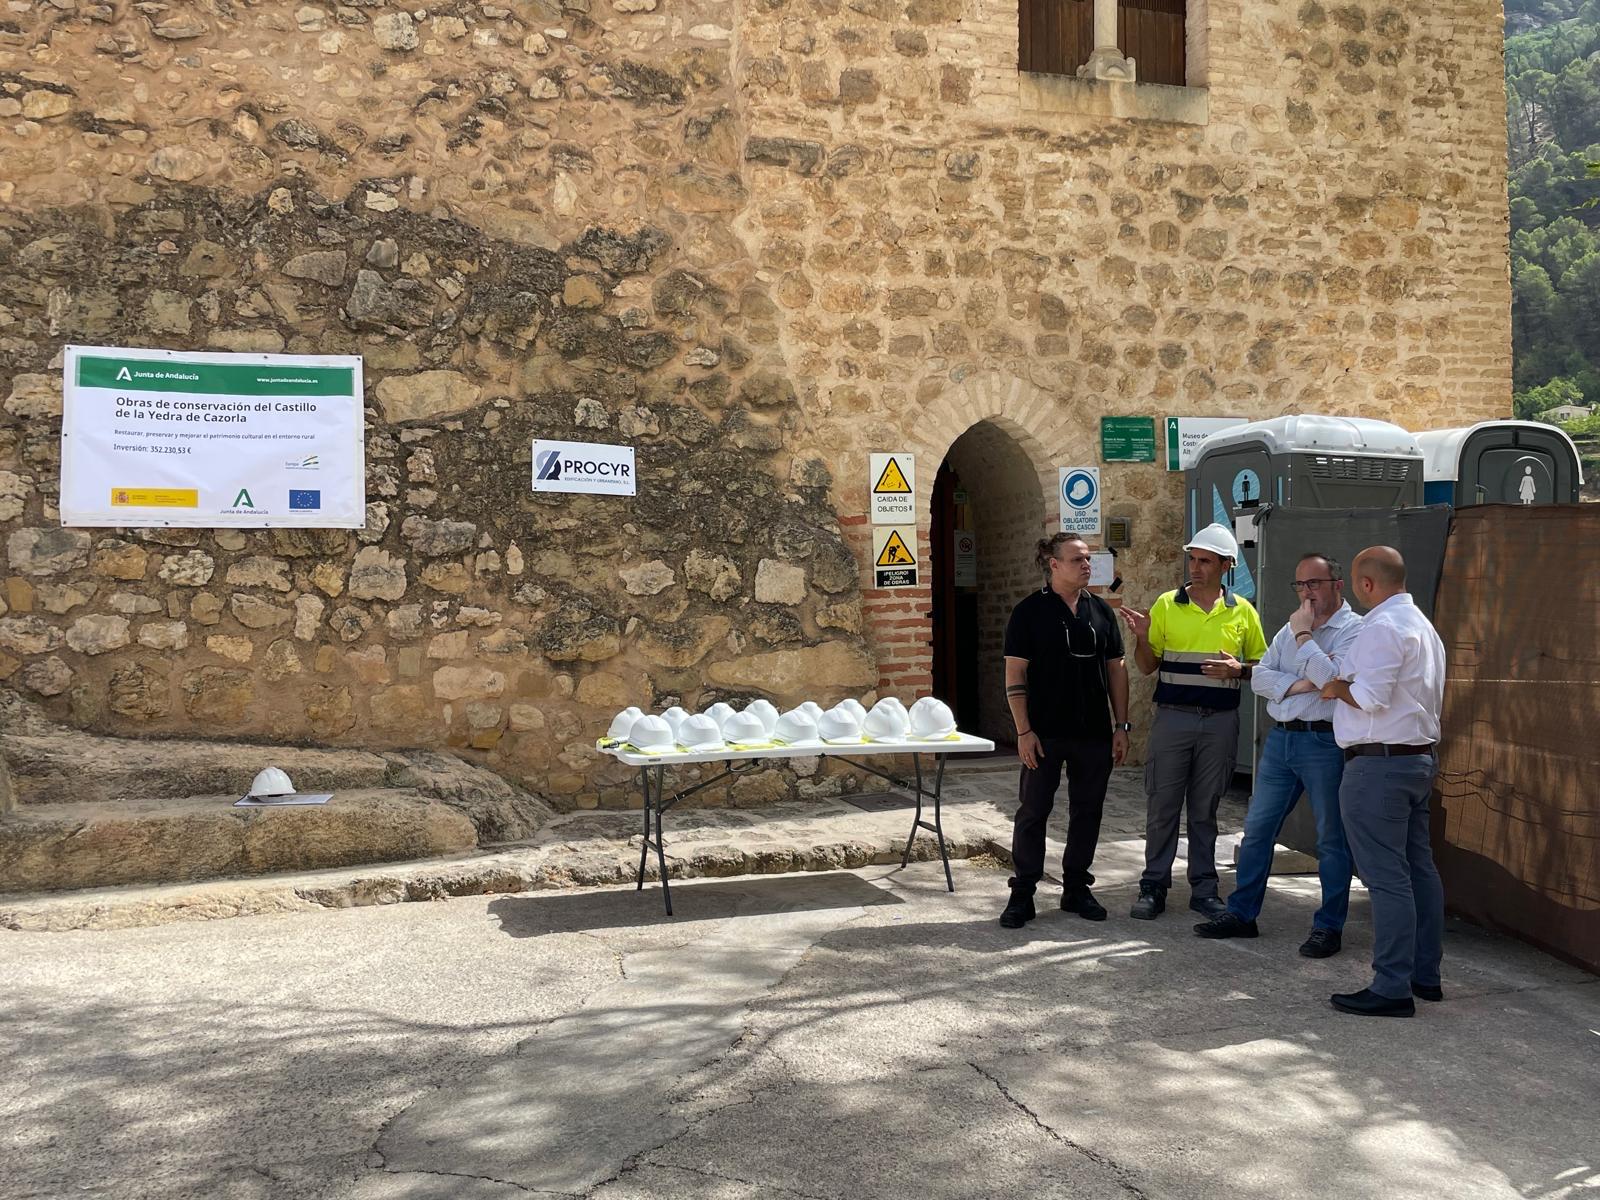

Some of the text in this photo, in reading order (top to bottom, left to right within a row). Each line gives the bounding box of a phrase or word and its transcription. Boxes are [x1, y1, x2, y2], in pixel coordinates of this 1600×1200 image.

[116, 397, 317, 412] Obras de conservación del Castillo
[116, 409, 247, 422] de la Yedra de Cazorla
[114, 444, 149, 452] Inversión:
[150, 446, 186, 454] 352.230,53
[564, 460, 630, 477] PROCYR
